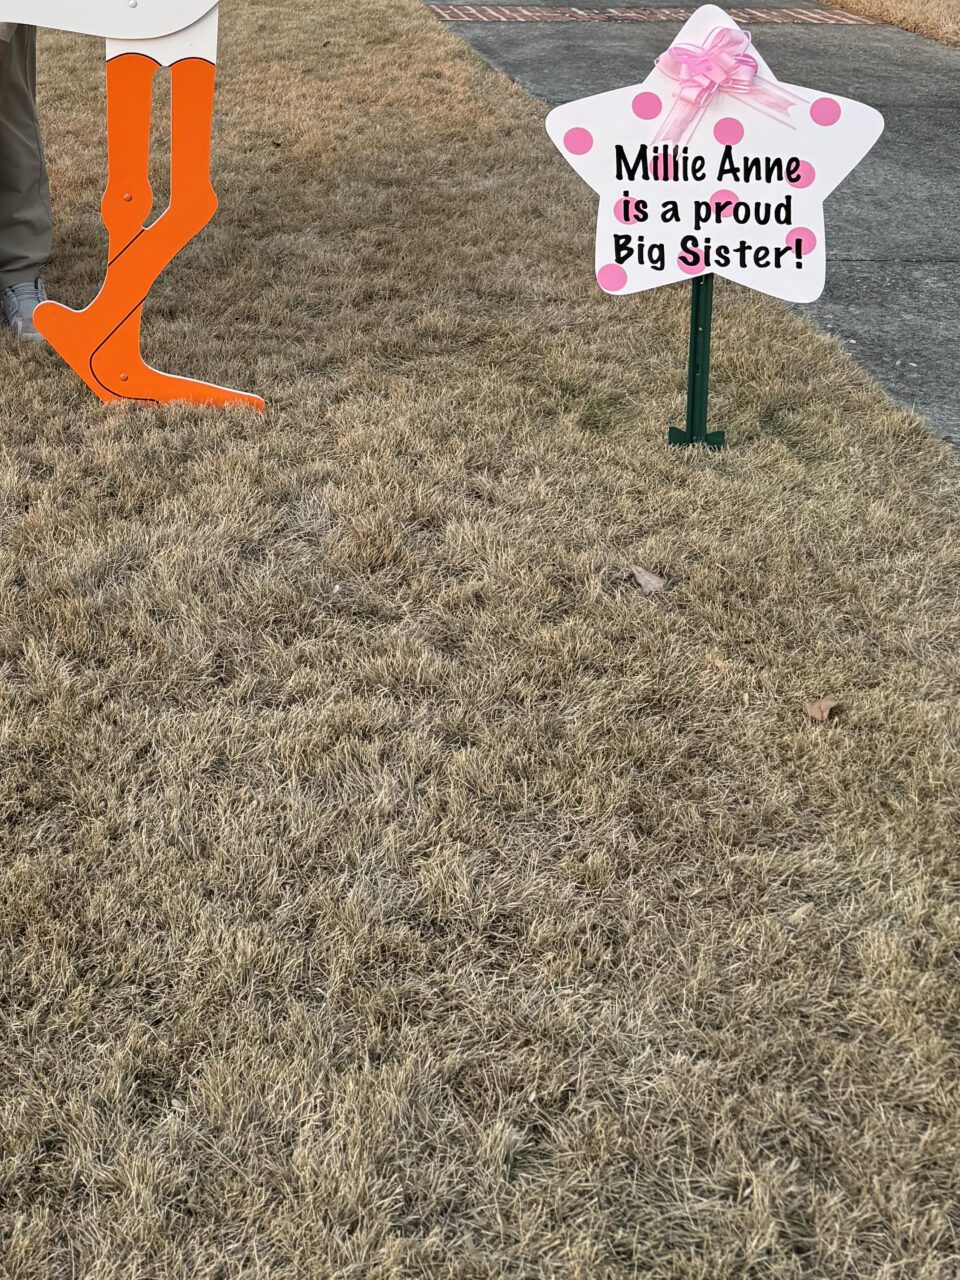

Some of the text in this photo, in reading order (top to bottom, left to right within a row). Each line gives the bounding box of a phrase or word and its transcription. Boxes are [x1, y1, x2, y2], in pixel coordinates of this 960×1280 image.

[614, 143, 802, 184] Millie Anne
[622, 190, 793, 231] is a proud
[613, 233, 804, 271] Big Sister!
